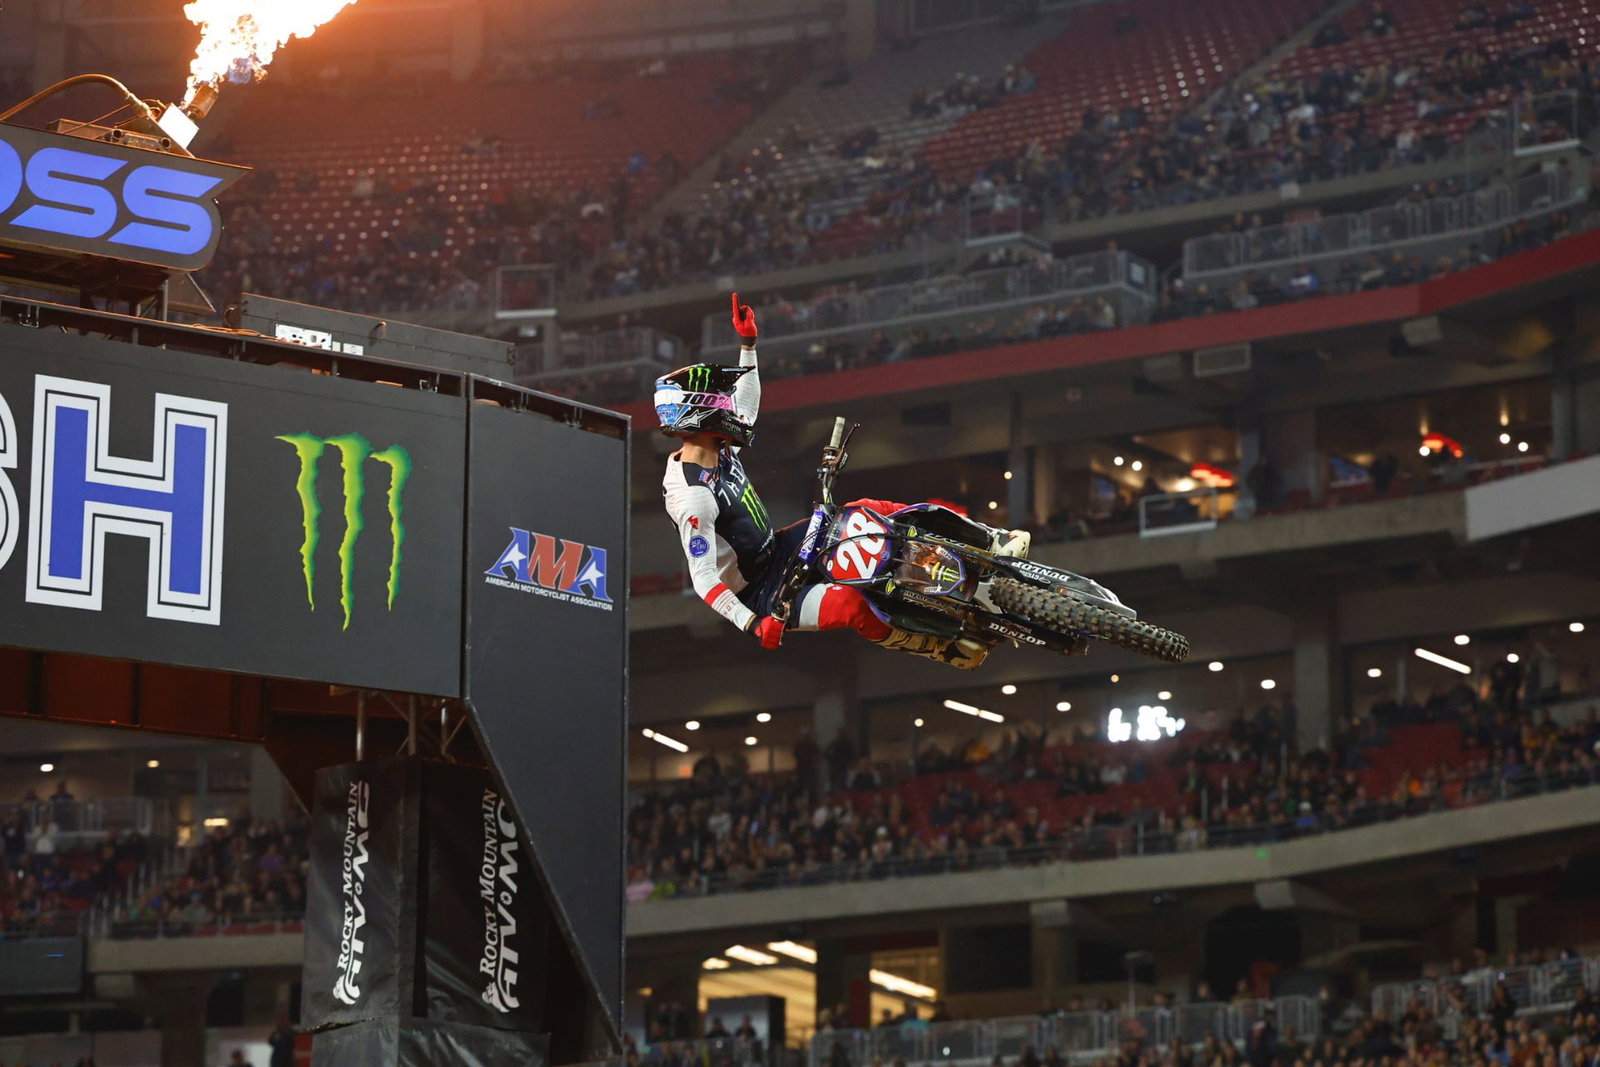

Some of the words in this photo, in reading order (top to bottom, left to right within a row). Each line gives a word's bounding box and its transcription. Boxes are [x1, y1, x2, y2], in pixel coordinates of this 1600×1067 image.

[0, 138, 224, 255] SS
[681, 393, 730, 409] 100%
[0, 374, 228, 626] H
[484, 526, 614, 602] AMA
[837, 511, 884, 579] 28
[1011, 561, 1071, 582] DUNLOP
[485, 577, 520, 590] AMERICAN
[520, 584, 570, 602] MOTORCYCLIST
[570, 595, 613, 611] ASSOCIATION
[989, 622, 1047, 645] DUNLOP
[342, 781, 358, 898] MOUNTAIN
[479, 787, 498, 905] MOUNTAIN
[337, 901, 354, 972] ROCKY
[480, 905, 498, 978] ROCKY
